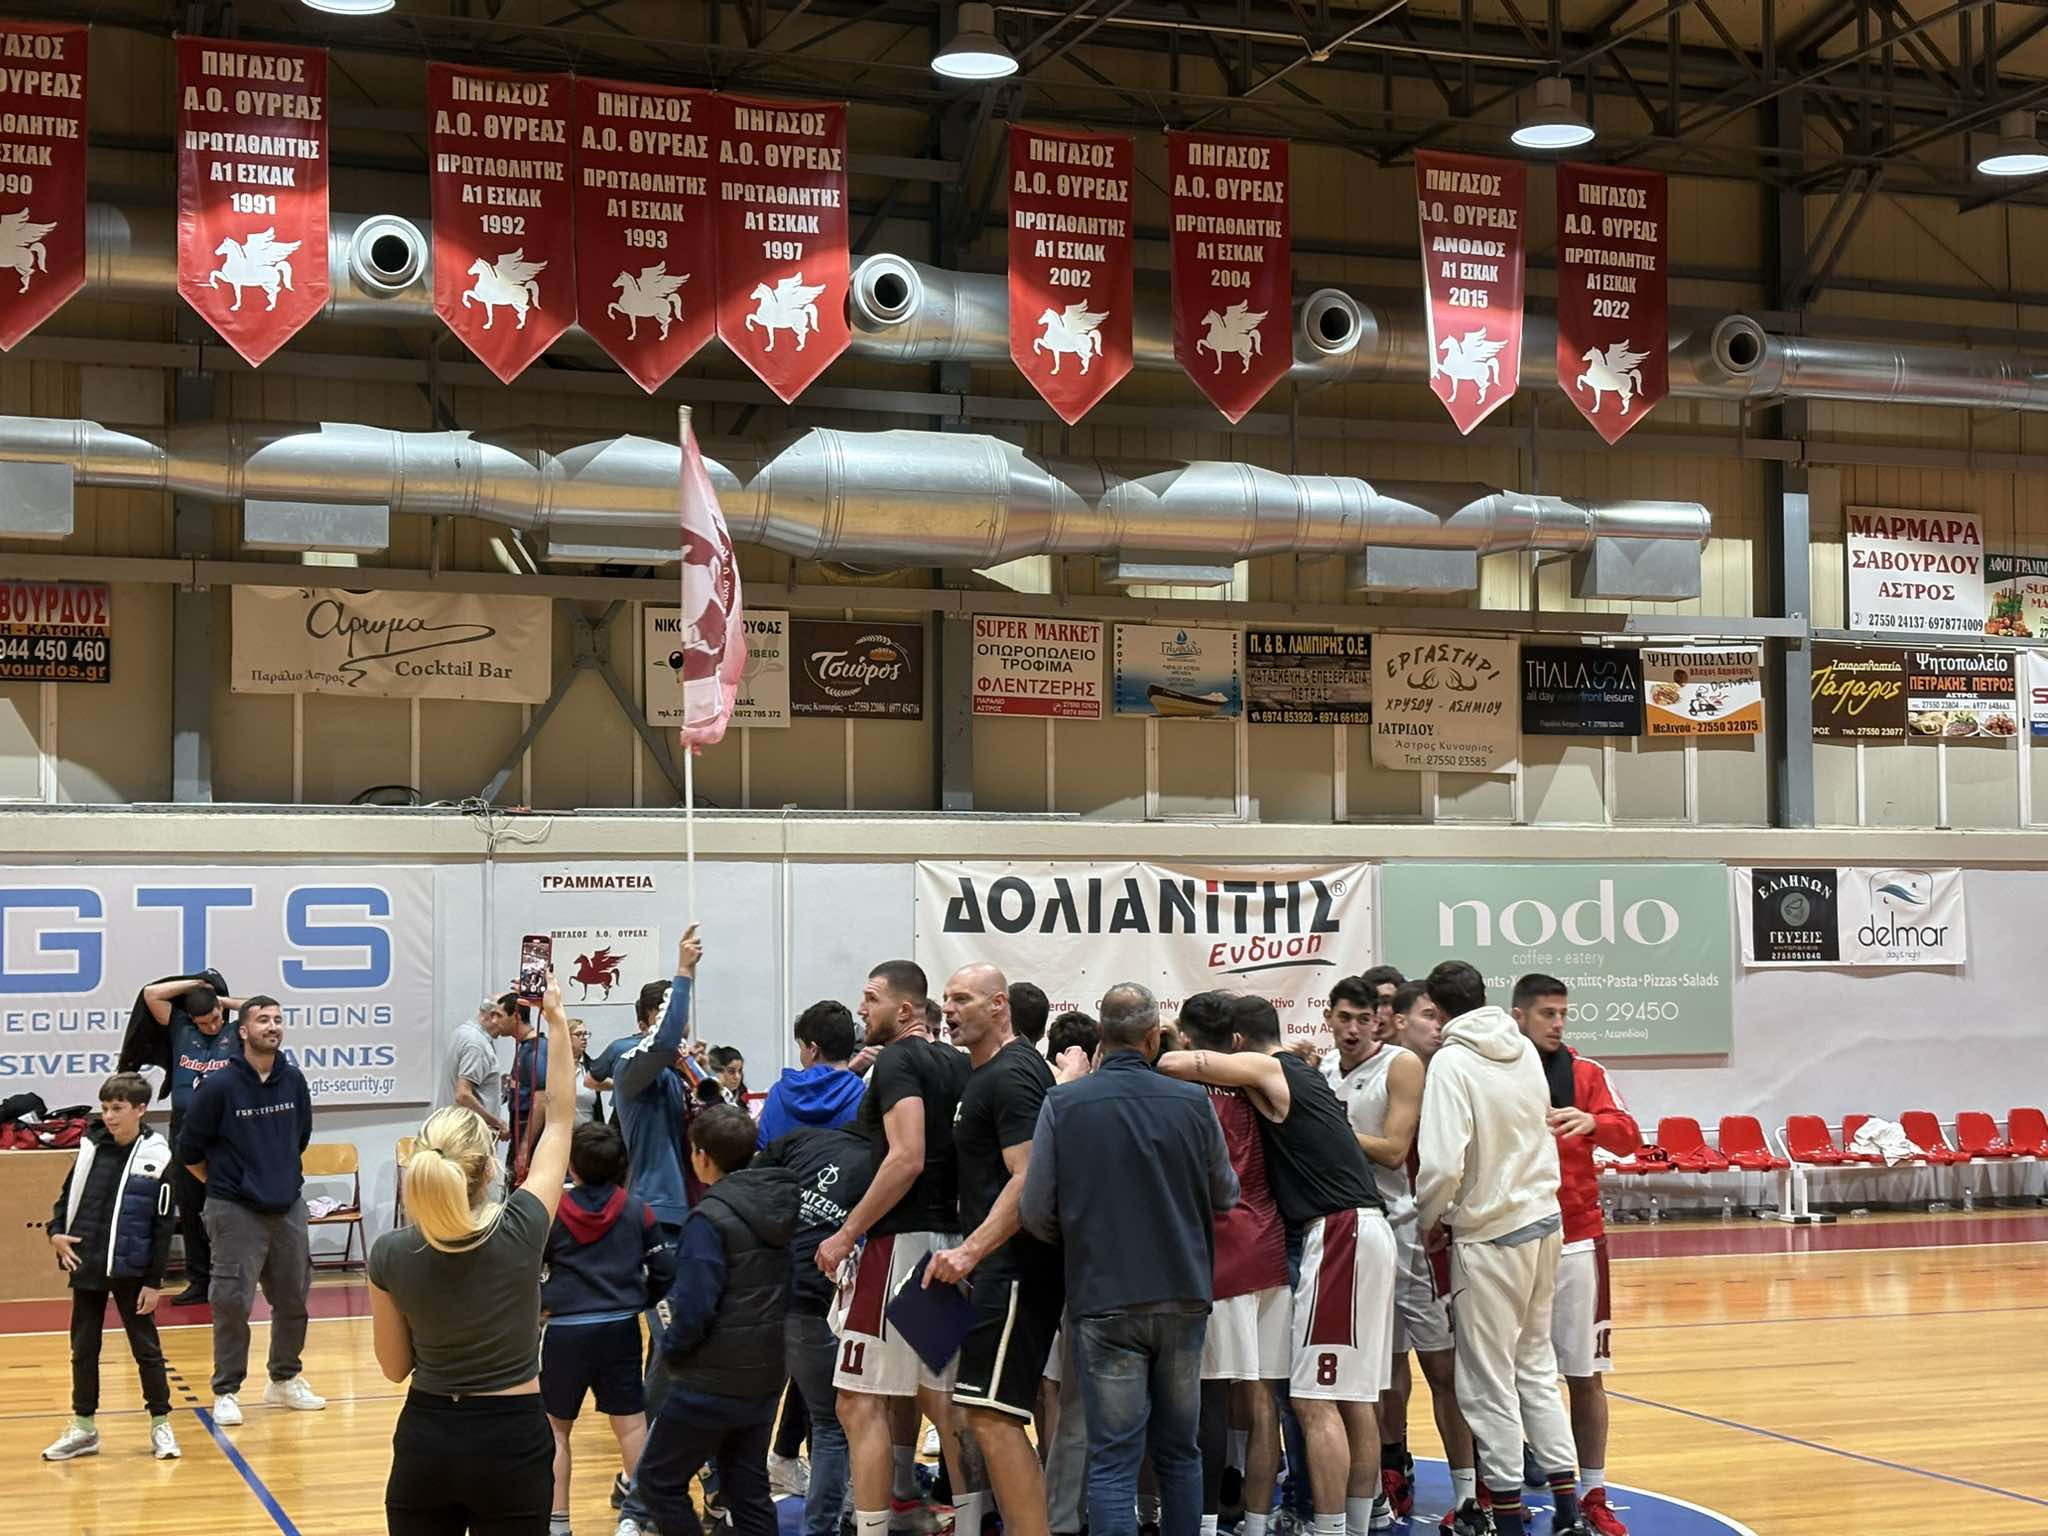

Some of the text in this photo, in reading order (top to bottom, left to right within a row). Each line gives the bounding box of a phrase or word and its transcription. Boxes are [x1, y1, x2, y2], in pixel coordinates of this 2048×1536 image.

[0, 33, 64, 60] ΑΣΟΣ
[202, 51, 304, 82] ΠΗΓΑΣΟΣ
[453, 77, 548, 107] ΠΗΓΑΣΟΣ
[184, 87, 321, 120] Α.Ο. ΘΥΡΕΑΣ
[598, 92, 691, 122] ΠΗΓΑΣΟΣ
[0, 114, 78, 138] ΘΛΗΤΗΣ
[435, 110, 565, 143] Α.Ο. ΘΥΡΕΑΣ
[736, 107, 825, 136] ΠΗΓΑΣΟΣ
[186, 131, 319, 159] ΠΡΩΤΑΘΛΗΤΗΣ
[582, 126, 708, 158] Α.Ο. ΘΥΡΕΑΣ
[720, 141, 841, 171] Α.Ο. ΘΥΡΕΑΣ
[1030, 139, 1114, 168] ΠΗΓΑΣΟΣ
[1189, 144, 1270, 170] ΠΗΓΑΣΟΣ
[211, 162, 295, 186] Α1 ΕΣΚΑΚ
[437, 154, 563, 181] ΠΡΩΤΑΘΛΗΤΗΣ
[584, 168, 706, 195] ΠΡΩΤΑΘΛΗΤΗΣ
[1015, 171, 1128, 202] Α.Ο. ΘΥΡΕΑΣ
[1175, 175, 1283, 203] Α.Ο. ΘΥΡΕΑΣ
[1427, 169, 1501, 196] ΠΗΓΑΣΟΣ
[231, 193, 275, 215] 1991
[462, 184, 541, 207] Α1 ΕΣΚΑΚ
[722, 183, 840, 208] ΠΡΩΤΑΘΛΗΤΗΣ
[1579, 184, 1646, 209] ΠΗΓΑΣΟΣ
[608, 199, 684, 222] Α1 ΕΣΚΑΚ
[1454, 205, 1517, 229] ΘΥΡΕΑΣ
[480, 215, 524, 234] 1992
[745, 212, 819, 233] Α1 ΕΣΚΑΚ
[1016, 211, 1125, 237] ΠΡΩΤΑΘΛΗΤΗΣ
[1176, 215, 1282, 238] ΠΡΩΤΑΘΛΗΤΗΣ
[1565, 214, 1657, 242] Α.Ο. ΘΥΡΕΑΣ
[624, 229, 667, 248] 1993
[1433, 237, 1505, 257] ΑΝΟΔΟΣ
[763, 241, 802, 260] 1997
[1035, 240, 1105, 262] Α1 ΕΣΚΑΚ
[1197, 242, 1263, 262] Α1 ΕΣΚΑΚ
[1566, 248, 1655, 270] ΠΡΩΤΑΘΛΗΤΗΣ
[1050, 268, 1090, 287] 2002
[1212, 269, 1250, 288] 2004
[1442, 261, 1498, 282] Α1 ΕΣΚΑΚ
[1587, 273, 1636, 293] Α1 ΕΣΚΑΚ
[1449, 288, 1488, 308] 2015
[1593, 299, 1629, 319] 2022
[1850, 515, 1980, 545] ΜΑΡΜΑΡΑ
[1852, 550, 1979, 574] ΣΑΒΟΥΡΔΟΥ
[1878, 582, 1955, 600] ΑΣΤΡΟΣ
[28, 625, 104, 636] ΚΑΤΟΙΚΙΑ
[976, 619, 1100, 644] SUPER MARKET
[1868, 614, 1896, 627] 27550
[34, 640, 67, 660] 450
[72, 640, 104, 662] 460
[977, 644, 1096, 661] ΟΠΩΡΟΠΩΛΕΙΟ
[1250, 634, 1368, 655] Π. & Β. ΛΑΜΠΙΡΗΣ Ο.Ε.
[395, 660, 512, 679] Cocktail Bar
[1002, 658, 1073, 674] ΤΡΟΦΙΜΑ
[1386, 644, 1500, 680] ΕΡΓΑΣΤΗΡΙ
[1648, 652, 1752, 667] ΨΗΤΟΠΩΛΕΙΟ
[1916, 652, 2008, 674] Ψητοπωλείο
[1526, 660, 1636, 690] THALASSA
[1711, 676, 1754, 692] DELIVERY
[1910, 676, 2014, 692] ΠΕΤΡΑΚΗΣ ΠΕΤΡΟΣ
[977, 676, 1096, 697] ΦΛΕΝΤΖΕΡΗΣ
[1291, 687, 1328, 701] ΠΕΤΡΑΣ
[1603, 692, 1635, 703] leisure
[1385, 698, 1502, 716] ΧΡΥΣΟΥ ΑΣΗΜΙΟΥ
[1378, 722, 1434, 736] ΙΑΤΡΙΔΟΥ
[1697, 722, 1726, 732] 27550
[1857, 728, 1880, 736] 27550
[1426, 754, 1456, 766] 27550
[1458, 756, 1487, 768] 23585
[542, 876, 654, 888] ΓΡΑΜΜΑΤΕΙΑ
[1758, 874, 1832, 900] ΕΛΛΗΝΩΝ
[1439, 879, 1680, 946] nodo
[0, 887, 391, 994] GTS
[1770, 931, 1822, 944] ΓΕΥΣΕΙΣ
[1858, 911, 1949, 948] delmar
[1208, 934, 1322, 967] Ενδυση
[1512, 950, 1605, 968] coffee eatery
[1606, 1002, 1679, 1022] 29450
[1288, 1024, 1316, 1035] Body
[840, 1340, 865, 1376] 11
[1317, 1353, 1338, 1386] 8
